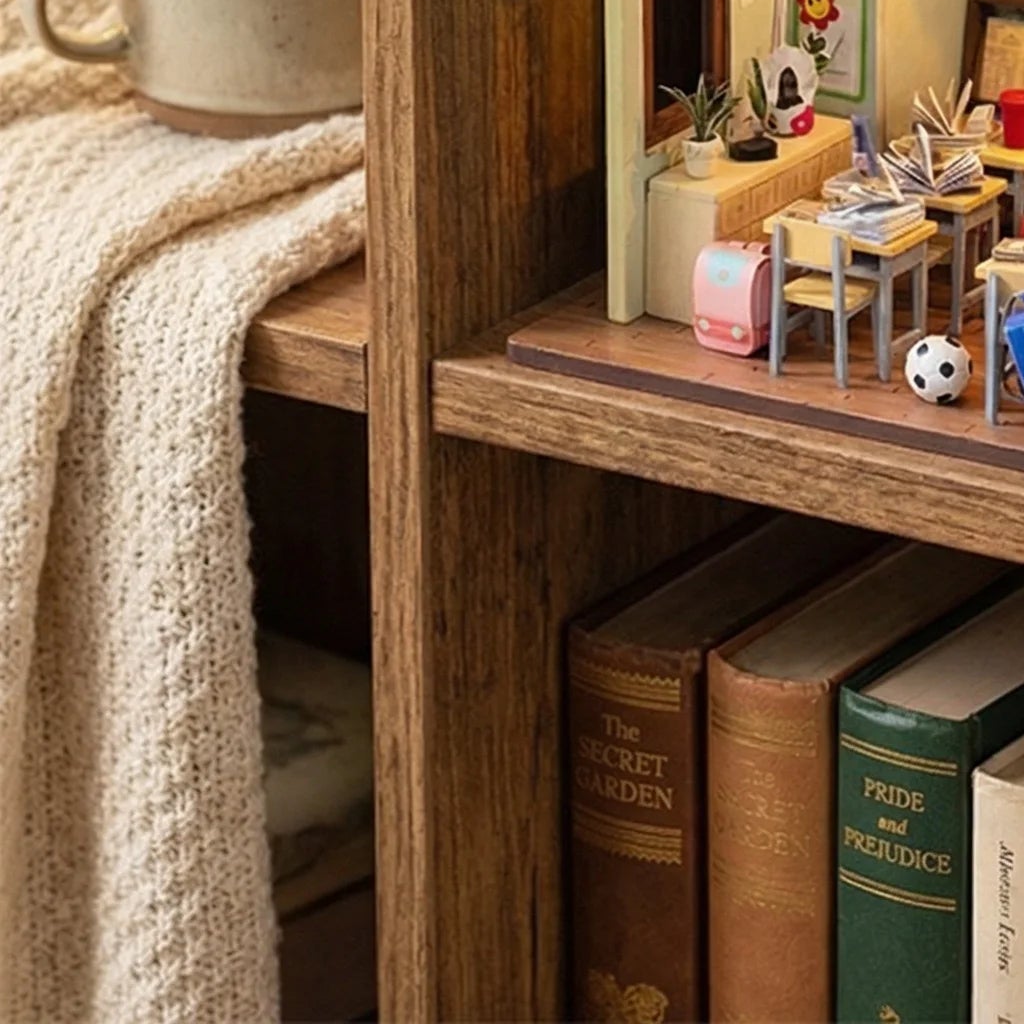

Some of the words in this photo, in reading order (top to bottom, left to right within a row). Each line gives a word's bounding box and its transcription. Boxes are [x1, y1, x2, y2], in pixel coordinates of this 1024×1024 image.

[600, 713, 641, 742] The
[576, 736, 668, 778] SECRET
[575, 766, 673, 810] GARDEN
[864, 777, 925, 813] PRIDE
[877, 815, 909, 836] and
[843, 825, 953, 875] PREJUDICE
